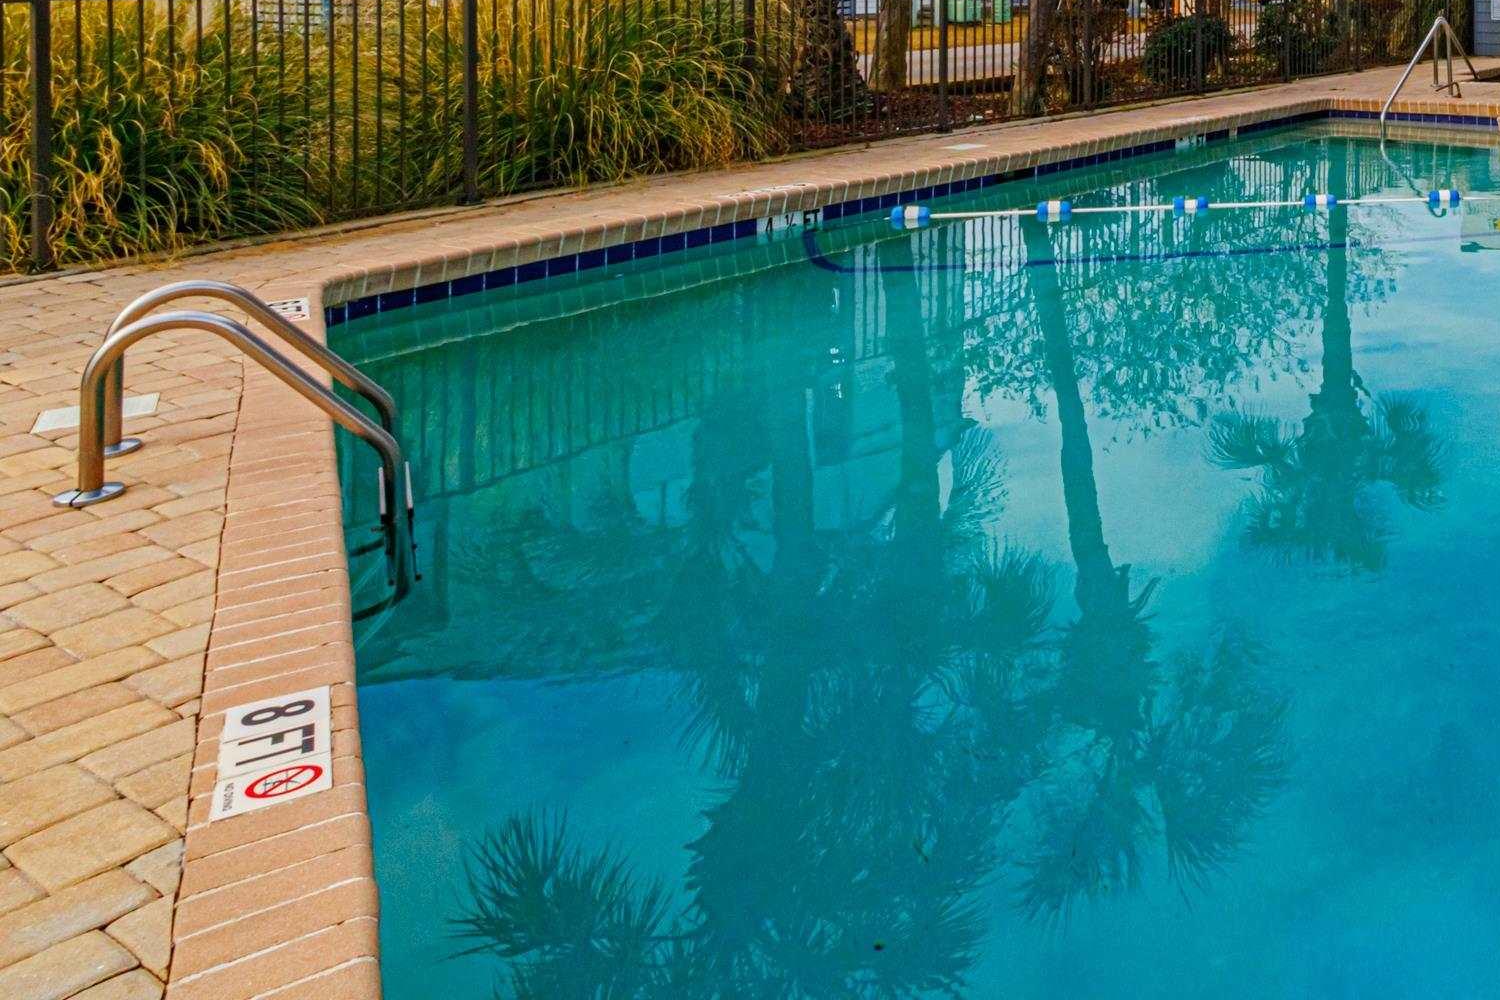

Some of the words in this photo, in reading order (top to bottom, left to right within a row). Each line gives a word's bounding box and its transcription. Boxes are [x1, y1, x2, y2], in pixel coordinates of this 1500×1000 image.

[803, 208, 820, 225] FT
[241, 699, 315, 726] 8
[235, 723, 315, 767] FT
